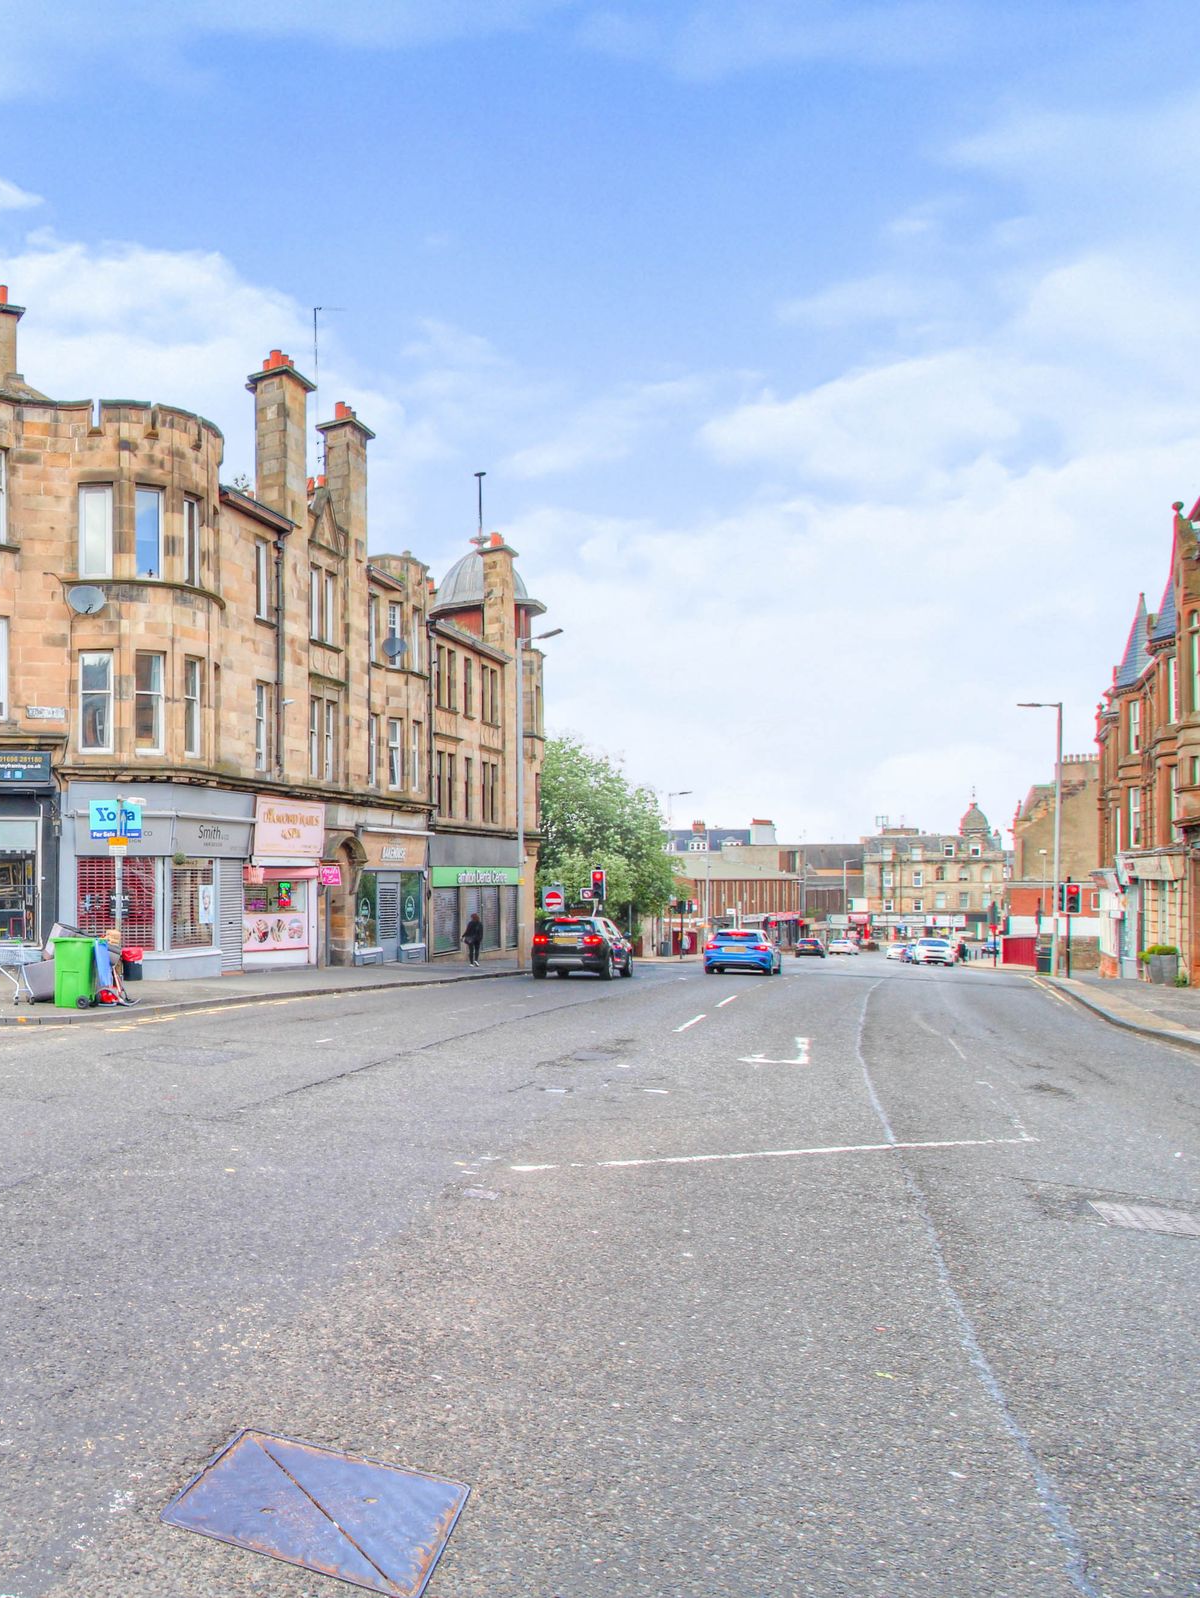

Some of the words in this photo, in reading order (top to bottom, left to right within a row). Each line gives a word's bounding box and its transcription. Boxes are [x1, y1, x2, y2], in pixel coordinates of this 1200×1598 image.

[96, 807, 135, 822] Yoa
[198, 824, 221, 840] Smith
[476, 870, 492, 884] Dental
